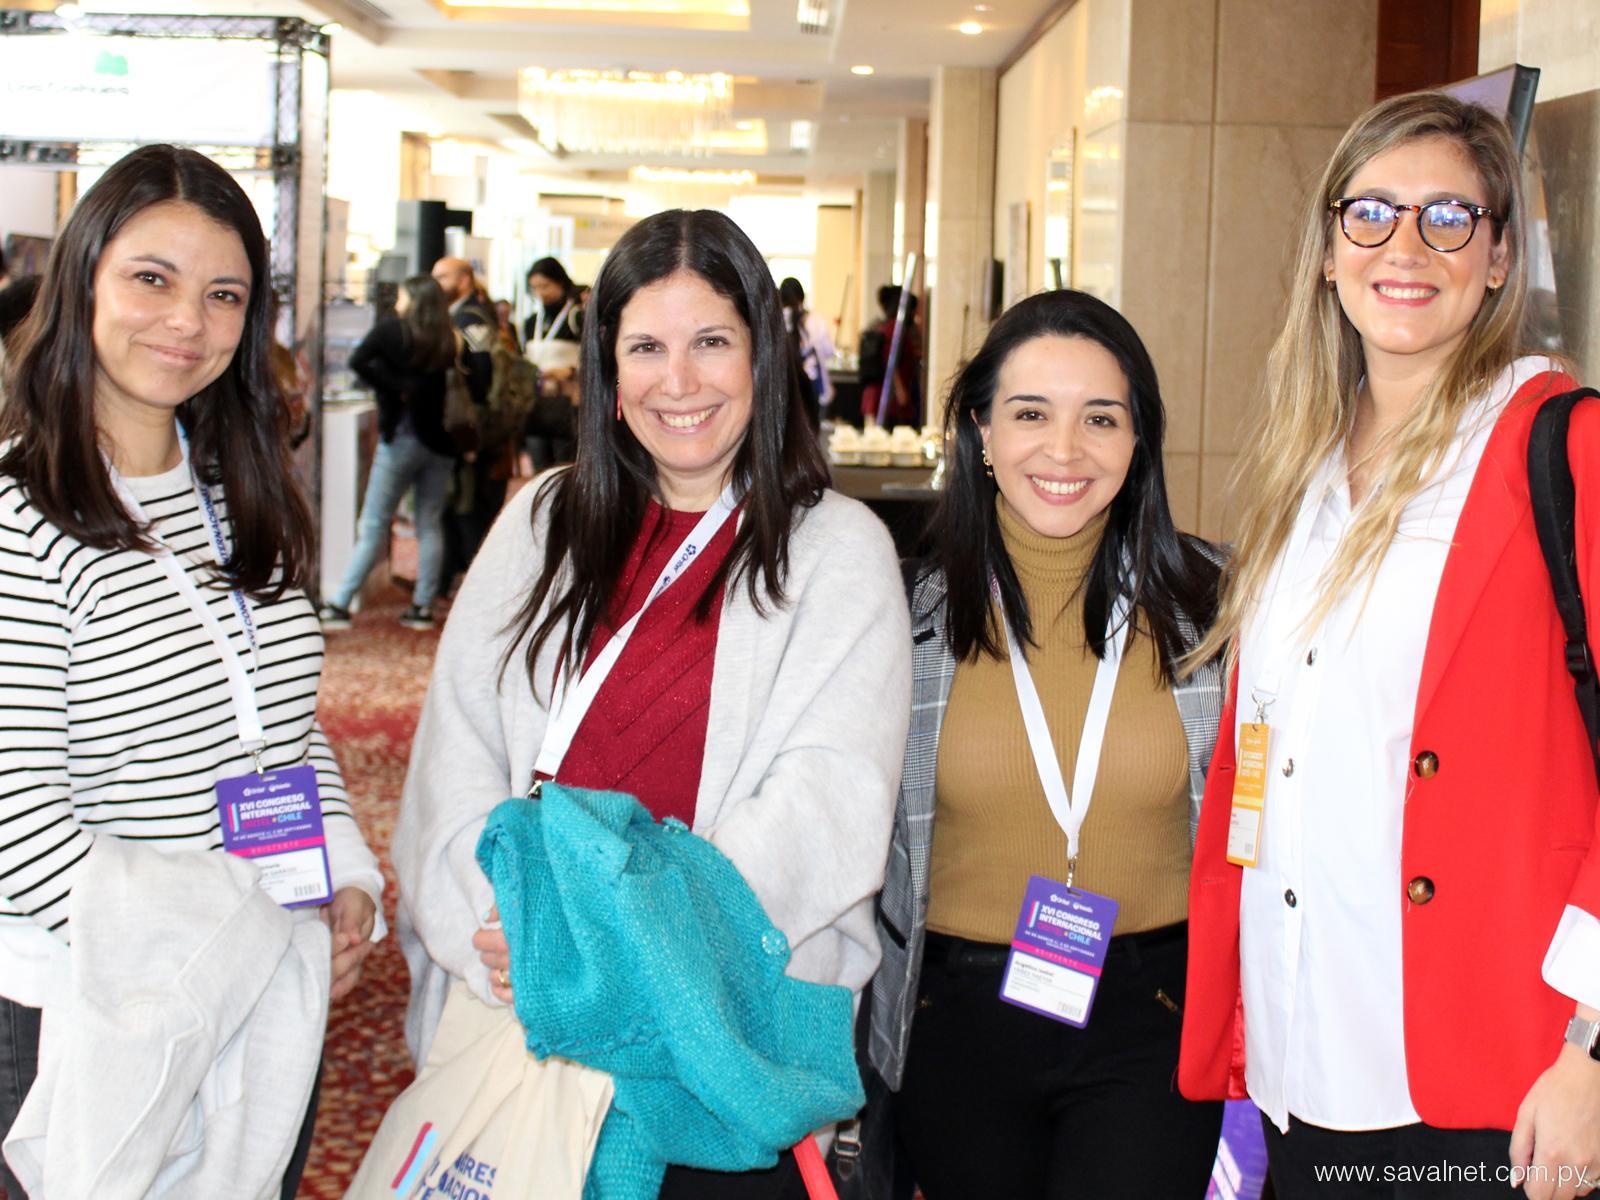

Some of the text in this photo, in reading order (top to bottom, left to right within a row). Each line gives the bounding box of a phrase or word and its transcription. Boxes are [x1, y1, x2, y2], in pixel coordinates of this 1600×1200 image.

[239, 792, 304, 812] XVI CONGRESO
[240, 801, 312, 820] INTERNACIONAL
[277, 811, 303, 823] CHILE
[1039, 912, 1102, 941] INTERNACIONAL
[1041, 904, 1100, 931] XVI CONGRESO
[1069, 931, 1091, 945] CHILE
